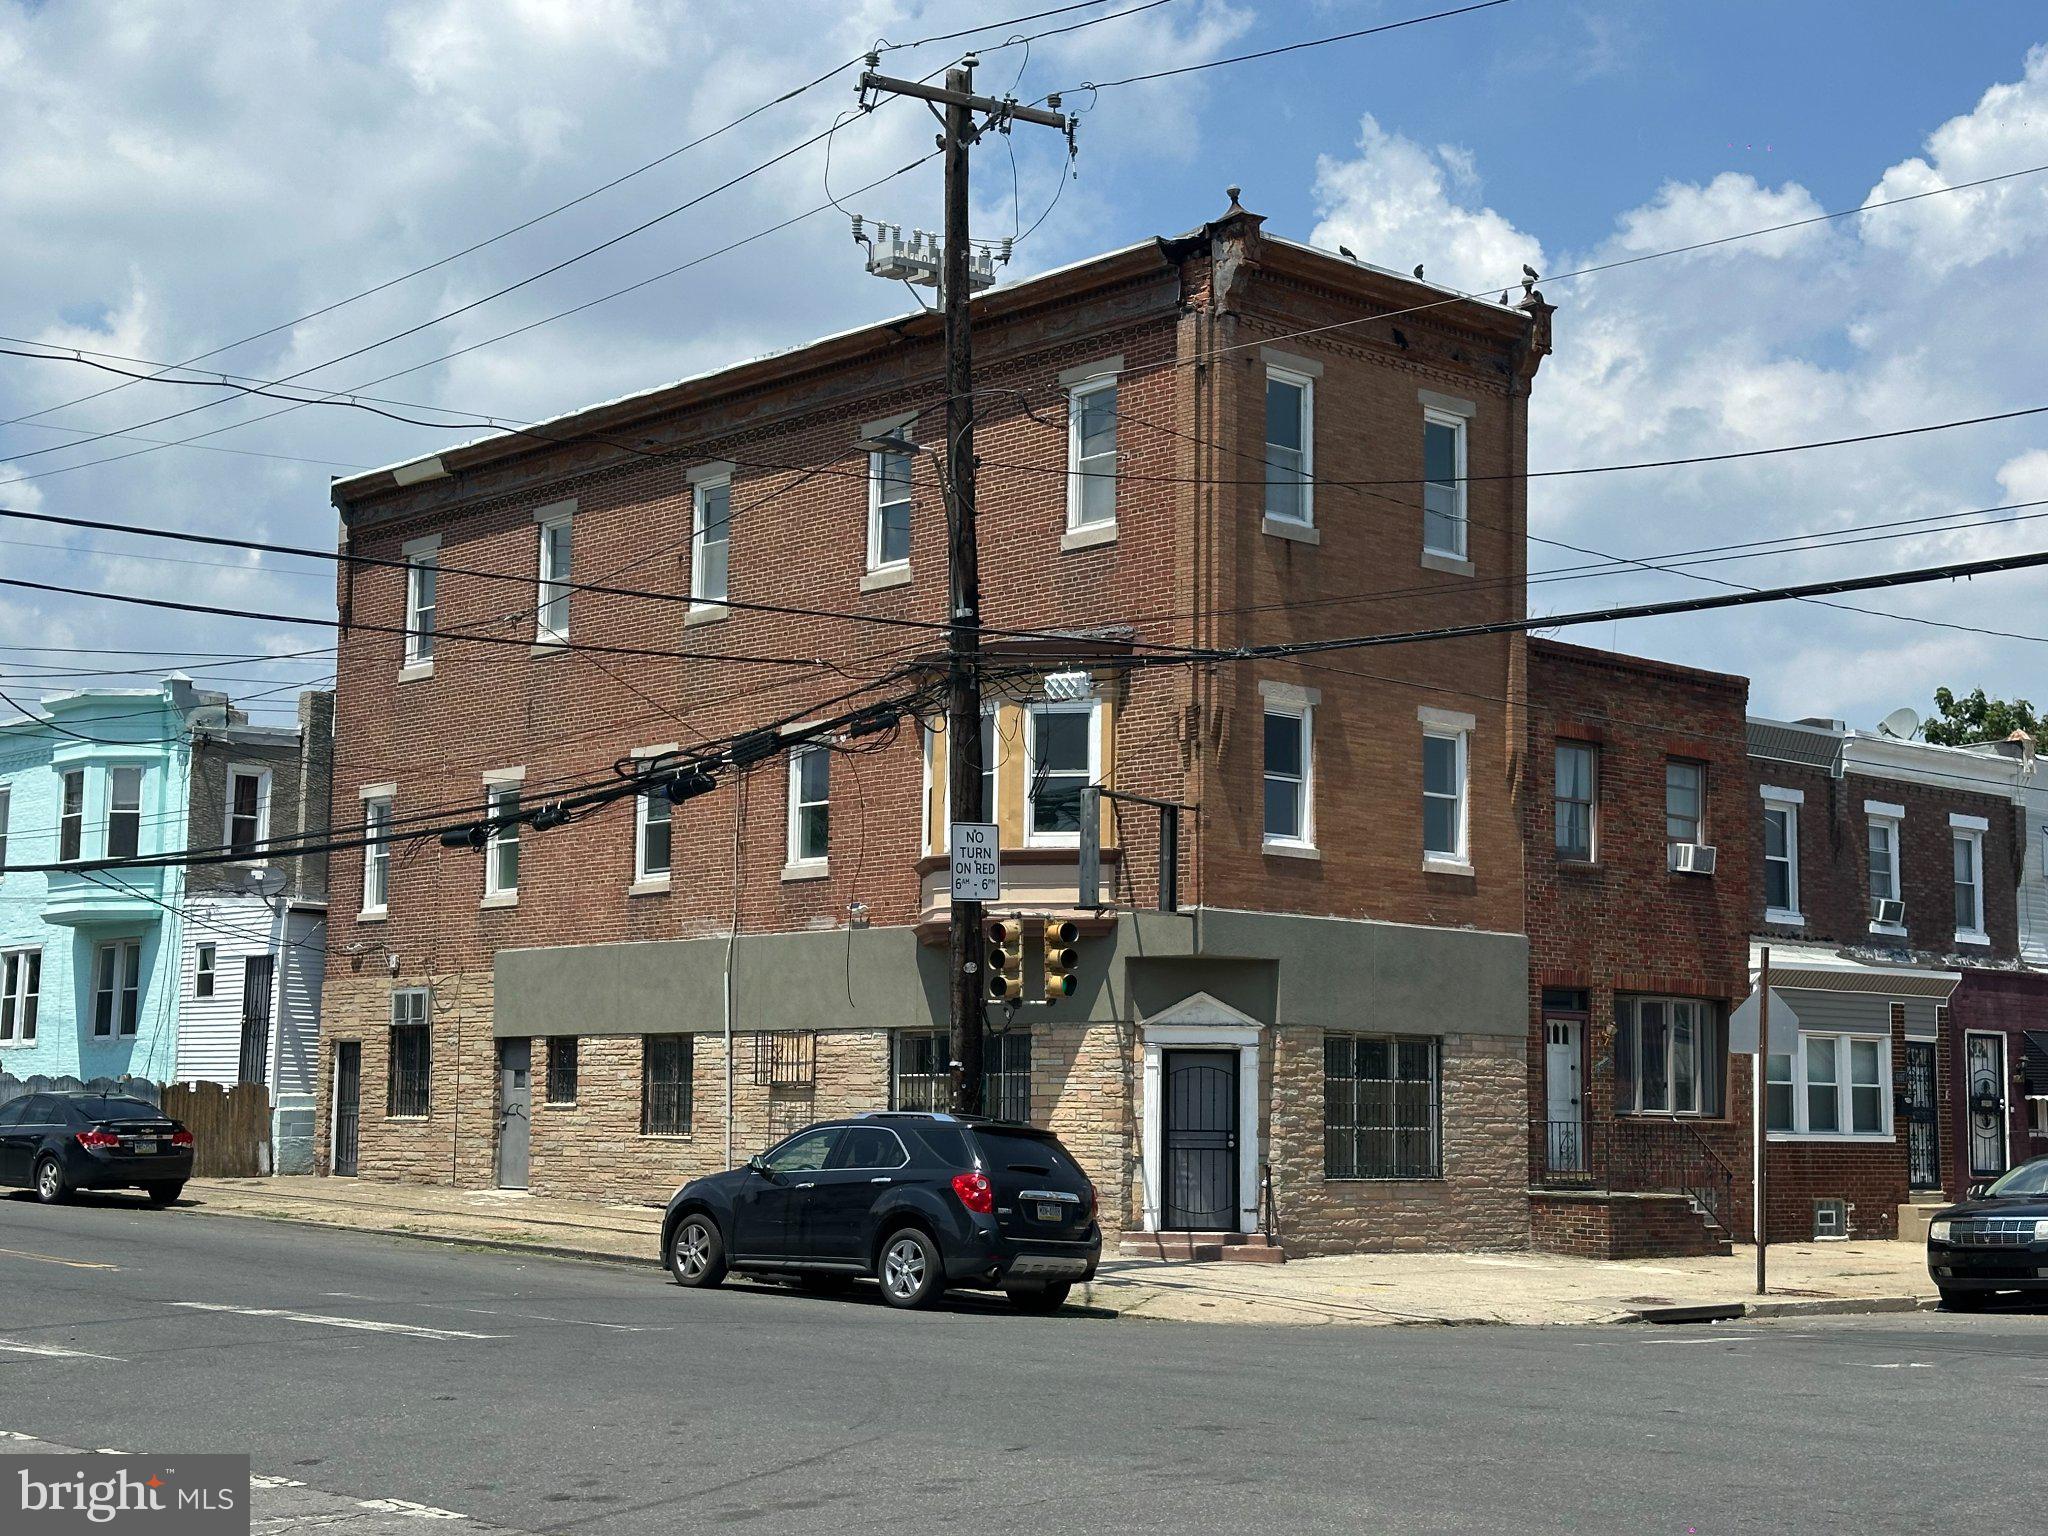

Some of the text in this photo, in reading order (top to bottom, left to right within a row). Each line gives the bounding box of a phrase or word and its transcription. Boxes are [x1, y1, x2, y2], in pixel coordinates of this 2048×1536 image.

[966, 831, 984, 843] NO
[960, 846, 991, 859] TURN
[955, 862, 996, 875] ON RED
